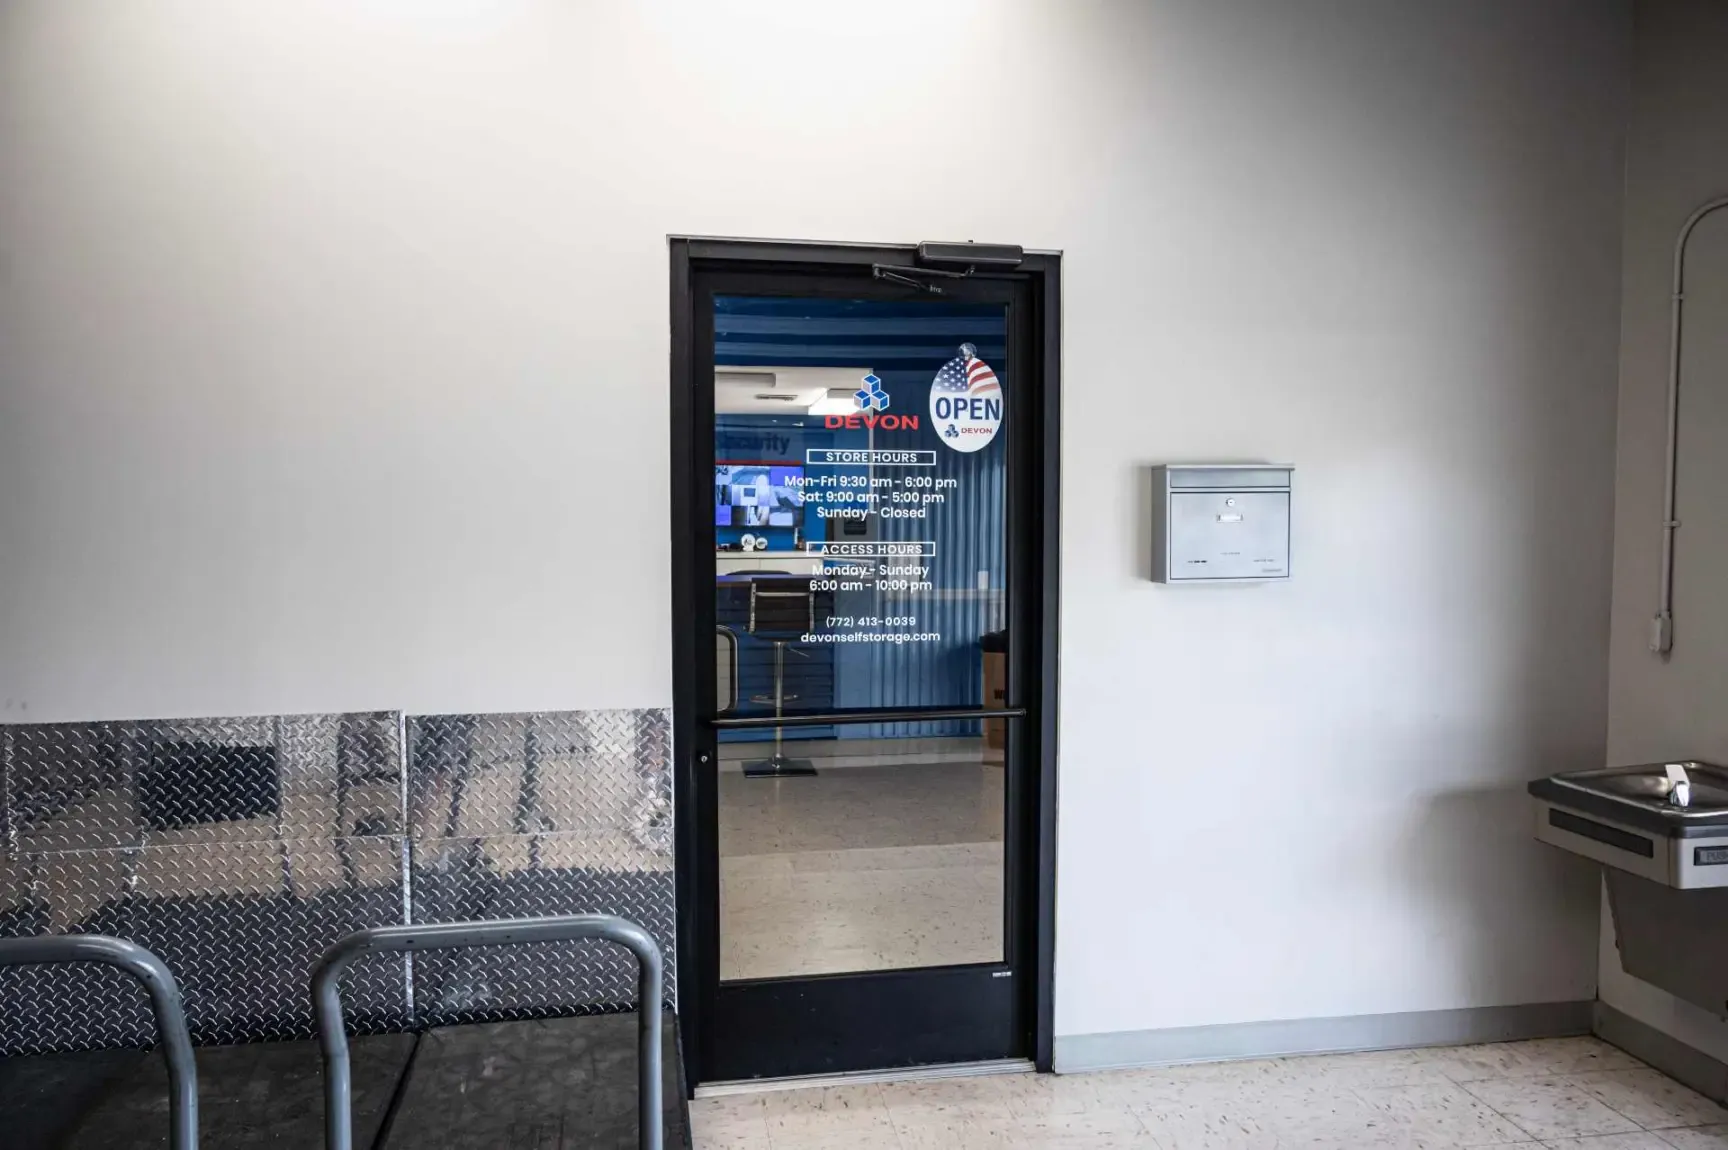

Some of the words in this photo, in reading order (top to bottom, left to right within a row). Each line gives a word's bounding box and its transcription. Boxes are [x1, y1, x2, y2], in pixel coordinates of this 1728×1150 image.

[935, 397, 1000, 420] OPEN
[824, 414, 919, 430] DEVON
[826, 452, 868, 462] STORE
[872, 453, 917, 463] HOURS
[784, 475, 837, 487] Mon-Fri
[840, 476, 867, 487] 9:30
[870, 478, 892, 487] am
[905, 476, 932, 487] 6:00
[935, 479, 957, 490] pm
[798, 491, 823, 503] Sat:
[826, 492, 854, 503] 9:00
[857, 494, 879, 503] am
[892, 492, 920, 503] 5:00
[922, 494, 944, 506] pm
[817, 506, 868, 521] Sunday
[880, 507, 926, 518] Closed
[821, 545, 874, 554] ACCESS
[878, 545, 923, 554] HOURS
[812, 564, 867, 579] Monday
[879, 564, 929, 579] Sunday
[809, 580, 837, 591] 6:00
[840, 582, 863, 591] am
[875, 580, 907, 591] 10:00
[910, 582, 932, 594] pm
[826, 616, 854, 627] (772)
[858, 616, 916, 626] 413-0039
[800, 631, 941, 645] devonselfstorage.com
